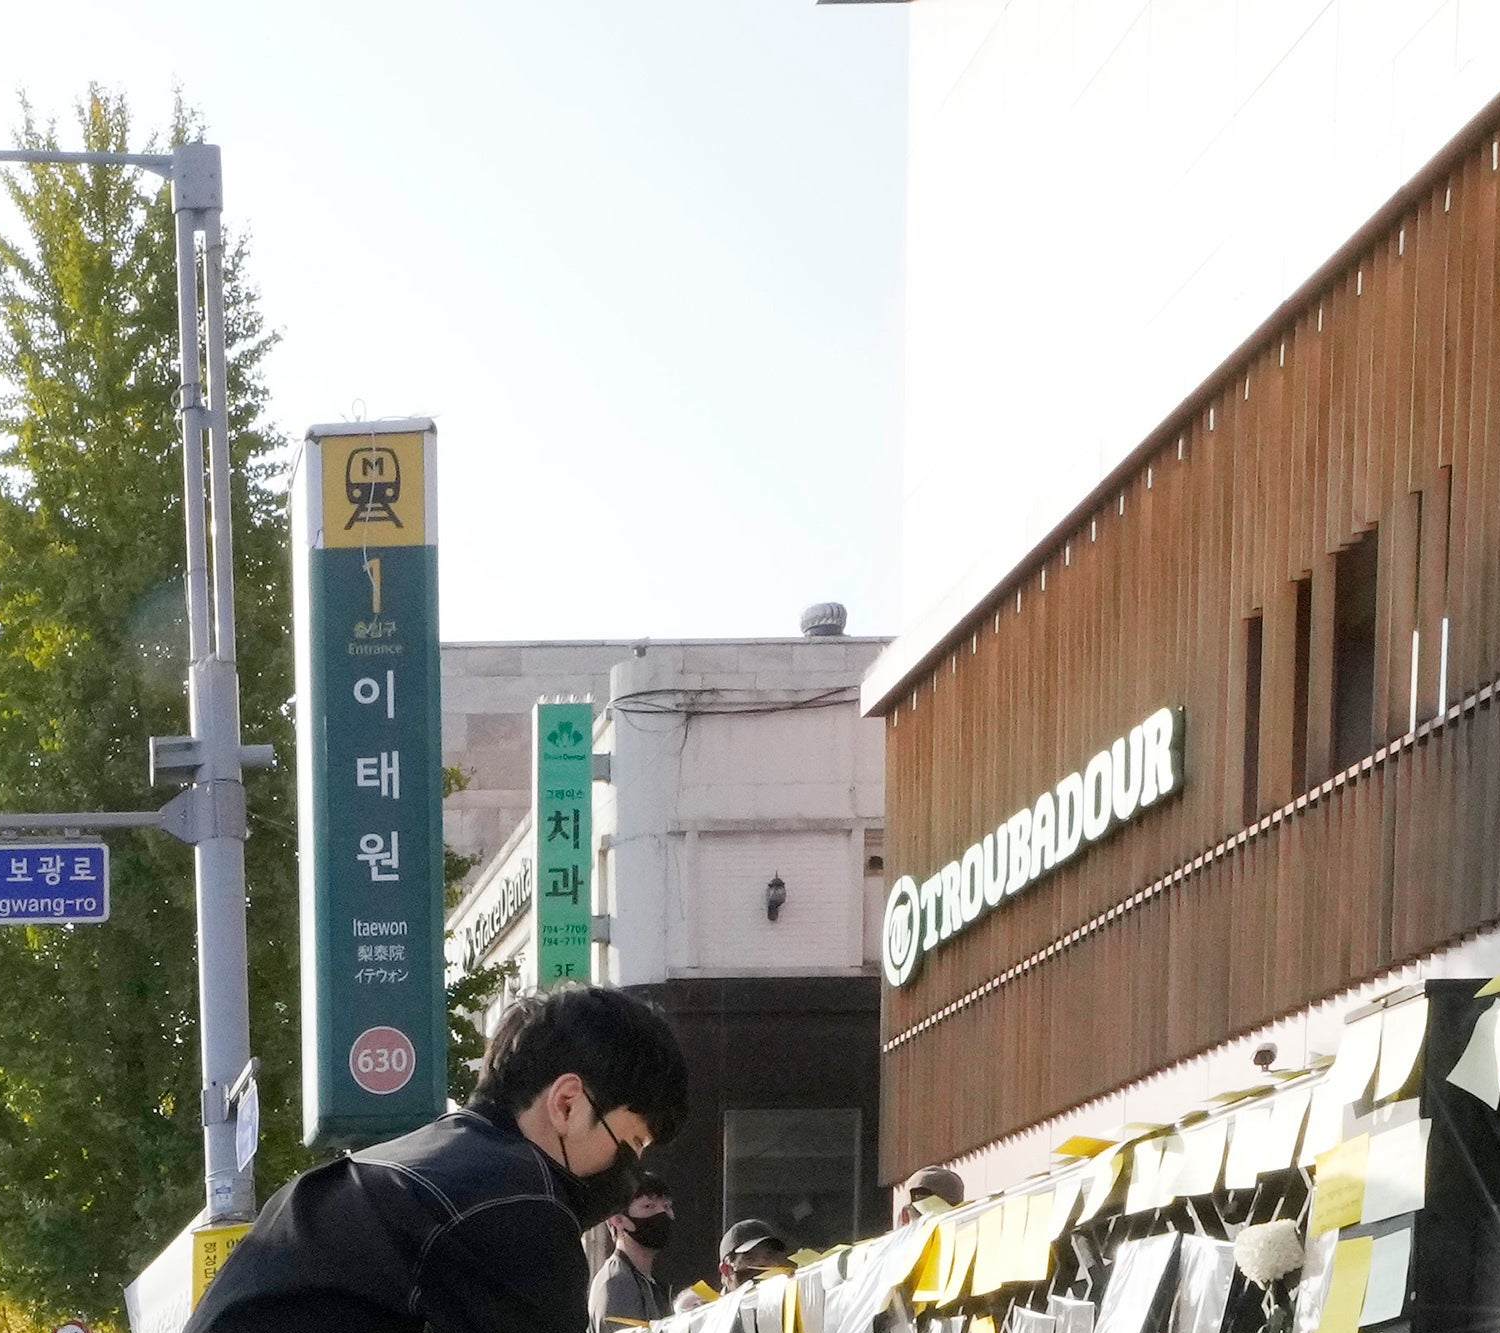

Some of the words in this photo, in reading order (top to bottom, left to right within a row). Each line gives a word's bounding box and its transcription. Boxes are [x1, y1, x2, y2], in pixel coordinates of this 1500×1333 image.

[364, 558, 381, 613] 1
[348, 643, 402, 655] Entrance
[353, 669, 399, 882] 이태원
[546, 788, 583, 799] 그레이스
[921, 707, 1174, 951] TROUBADOUR
[545, 808, 584, 904] 치과
[6, 854, 97, 886] 보광로
[353, 918, 407, 937] Itaewon
[357, 944, 406, 962] 梨泰院
[355, 967, 409, 983] イテウォン
[554, 964, 575, 977] 3F
[357, 1048, 407, 1073] 630
[203, 1242, 217, 1289] 영상단
